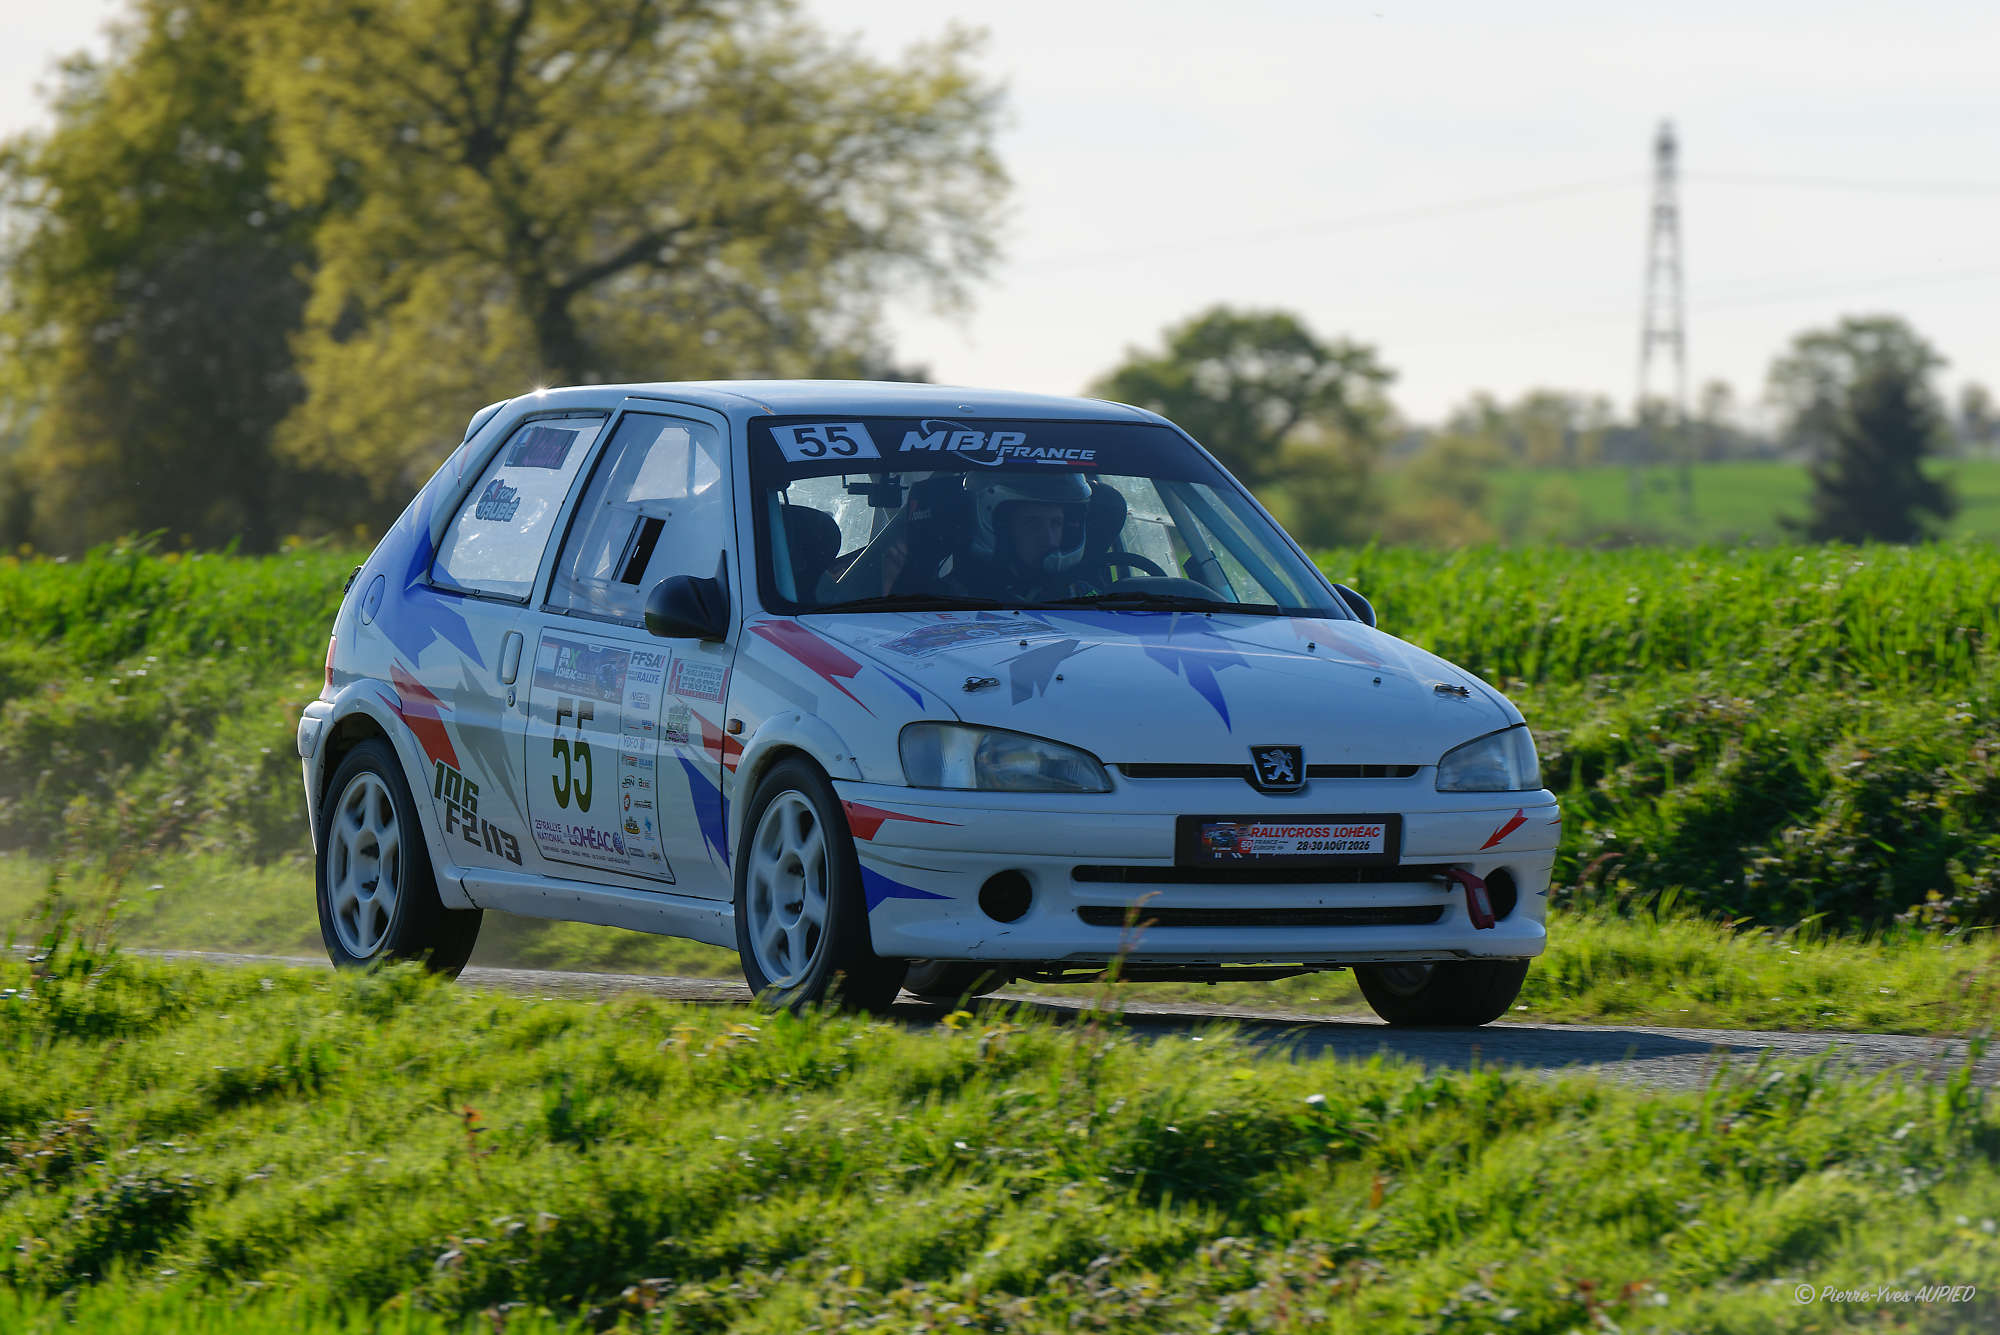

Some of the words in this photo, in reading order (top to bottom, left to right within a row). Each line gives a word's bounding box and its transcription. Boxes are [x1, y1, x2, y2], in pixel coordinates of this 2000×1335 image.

[793, 427, 858, 457] 55
[899, 431, 1026, 451] MBP
[998, 445, 1097, 461] FRANCE
[552, 696, 595, 813] 55
[434, 760, 480, 815] 106
[566, 825, 614, 852] LOHÉAC
[1250, 826, 1330, 838] RALLYCROSS
[1333, 825, 1380, 838] LOHÉAC
[1296, 840, 1322, 851] 28-30
[1348, 840, 1370, 851] 2026
